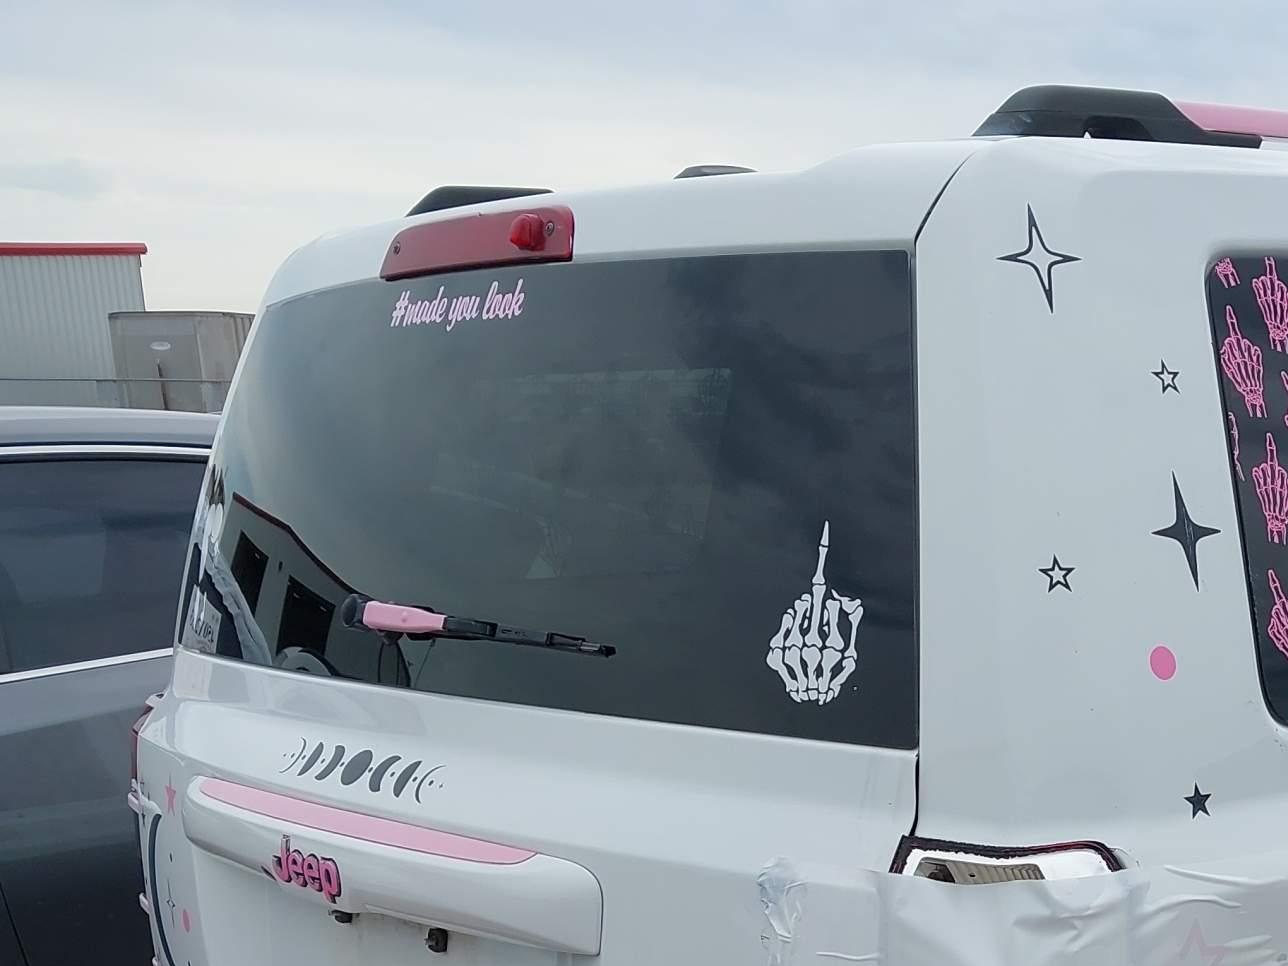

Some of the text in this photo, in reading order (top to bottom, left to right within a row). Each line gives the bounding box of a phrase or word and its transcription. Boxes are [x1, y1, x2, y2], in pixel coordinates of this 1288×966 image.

[446, 295, 480, 332] you
[482, 278, 525, 320] look
[271, 836, 342, 904] Jeep
